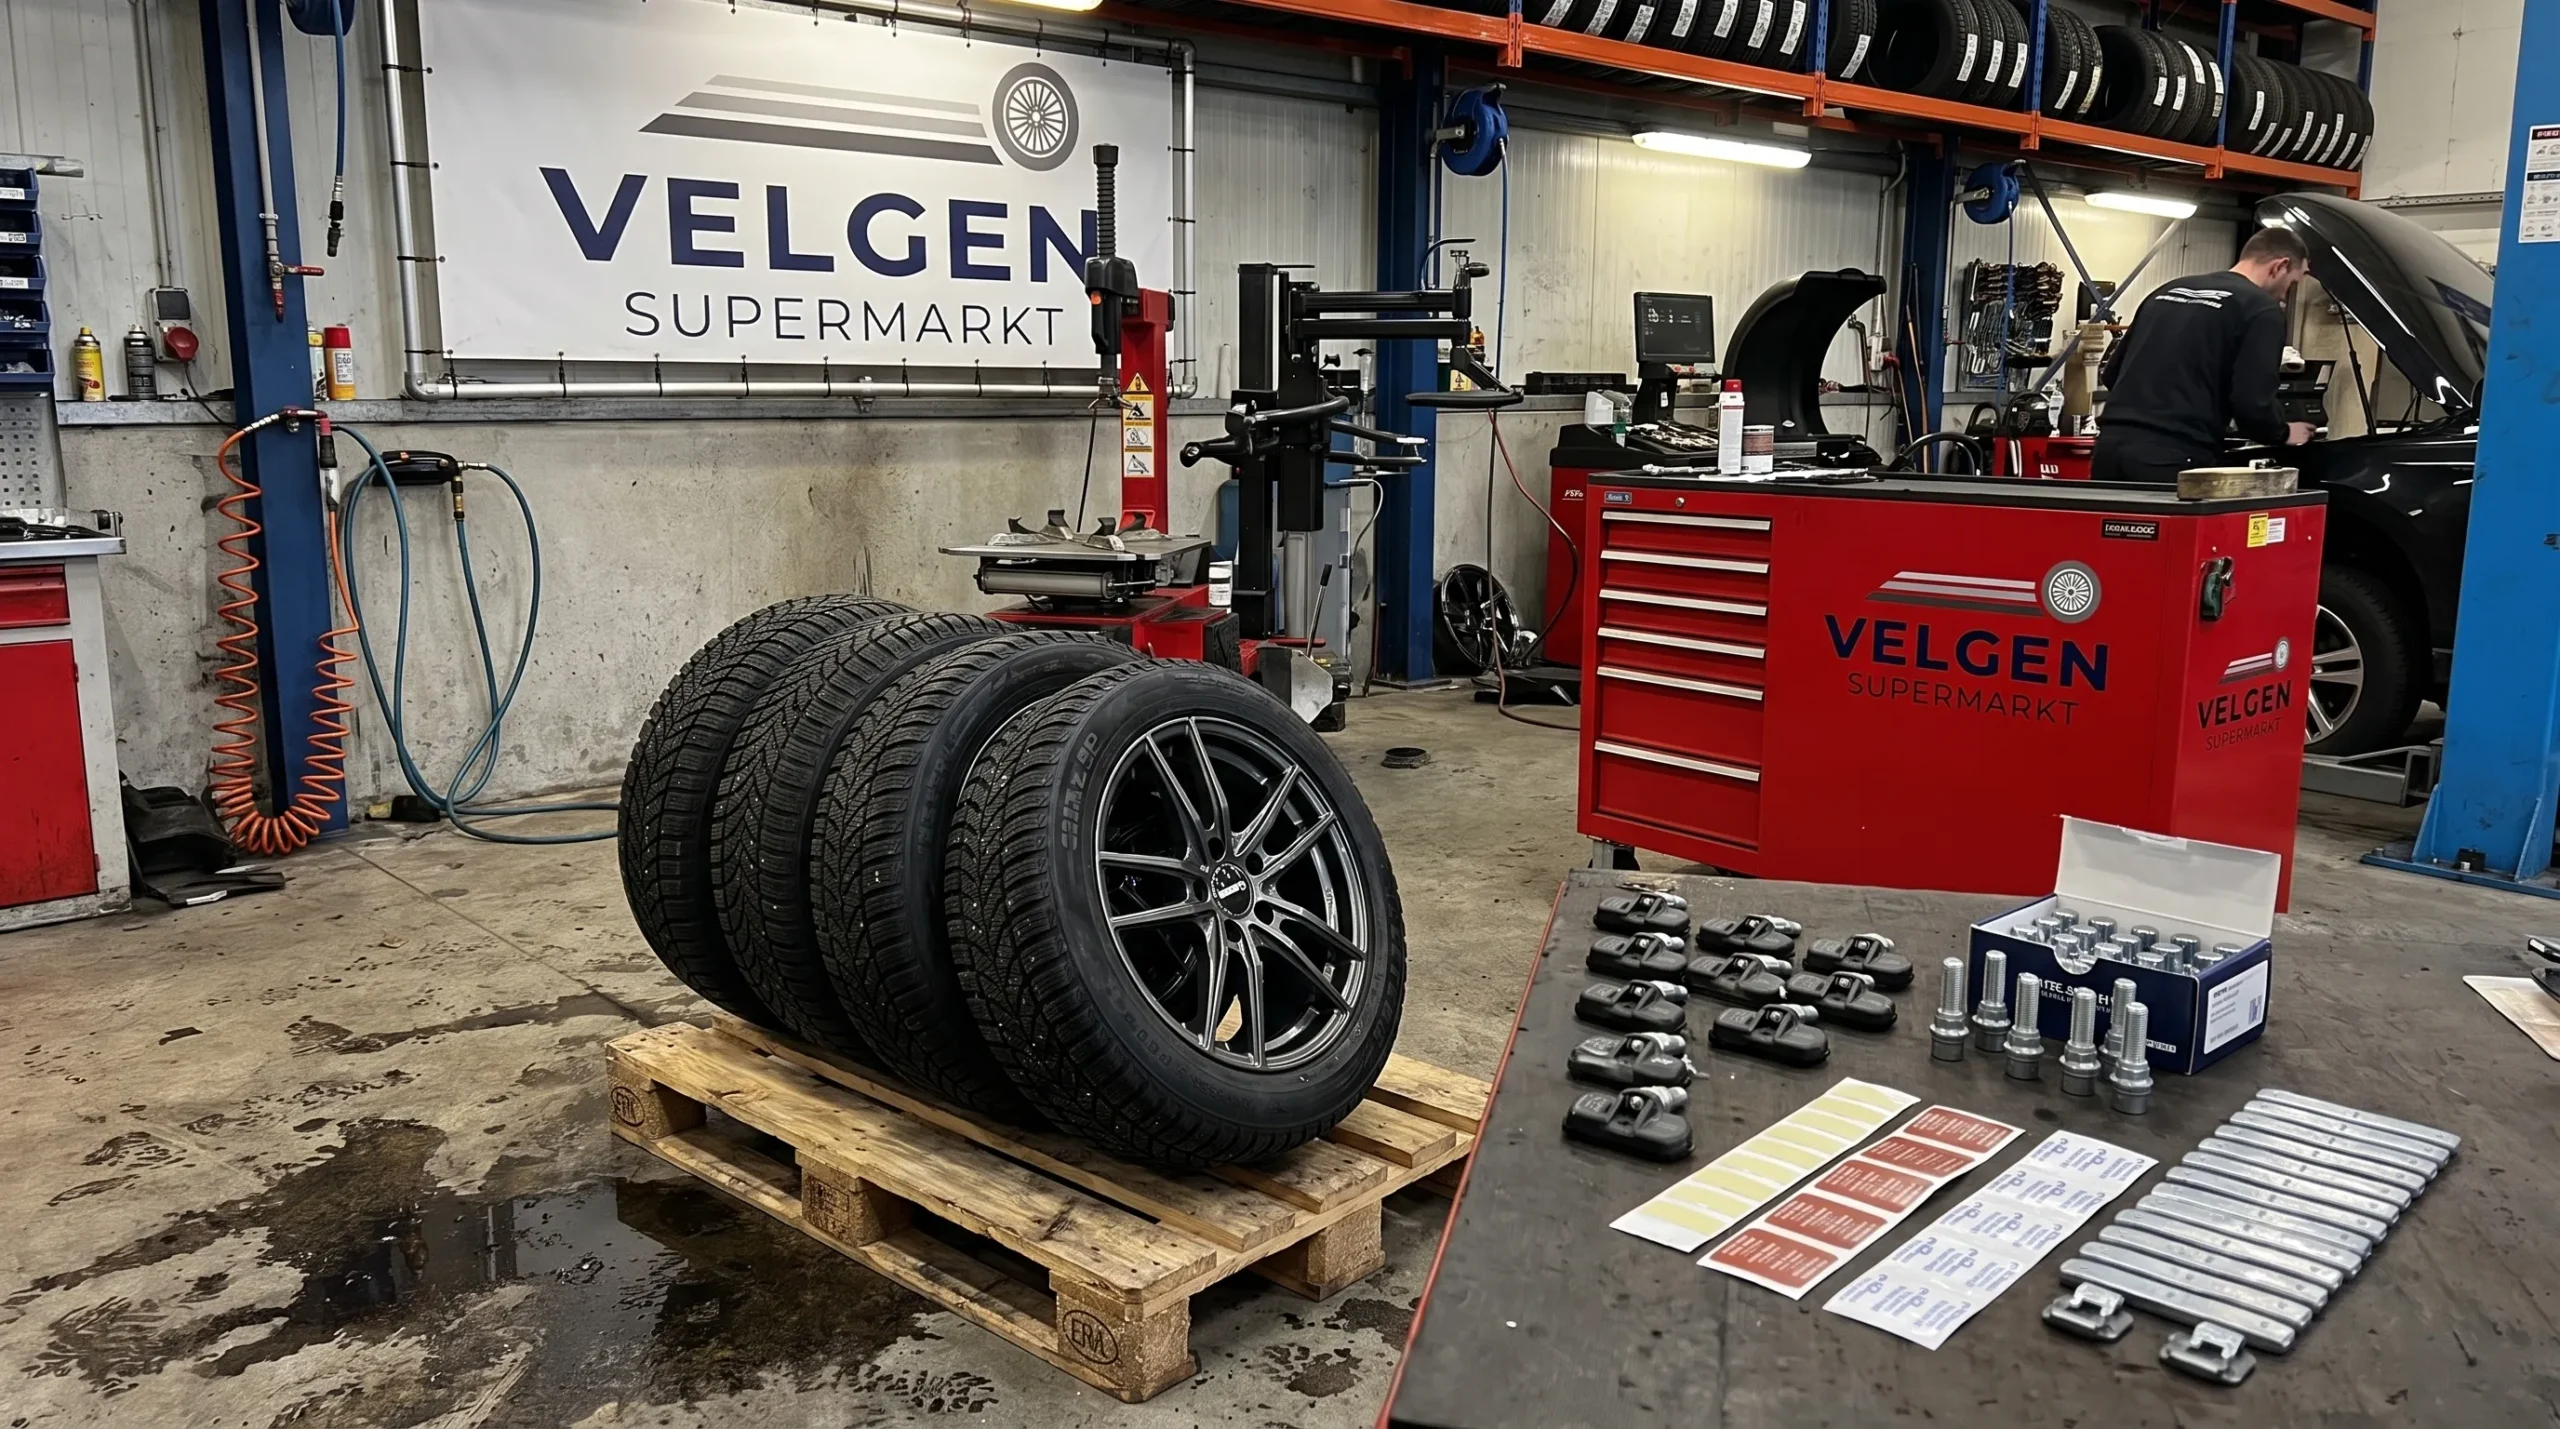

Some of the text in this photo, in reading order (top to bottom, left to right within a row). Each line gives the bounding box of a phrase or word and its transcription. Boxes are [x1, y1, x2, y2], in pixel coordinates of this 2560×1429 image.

[539, 166, 1098, 284] VELGEN
[624, 291, 1064, 346] SUPERMARKT
[1824, 614, 2109, 692] VELGEN
[1847, 672, 2079, 726] SUPERMARKT
[2197, 680, 2292, 730] VELGEN
[2204, 717, 2283, 752] SUPERMARKT
